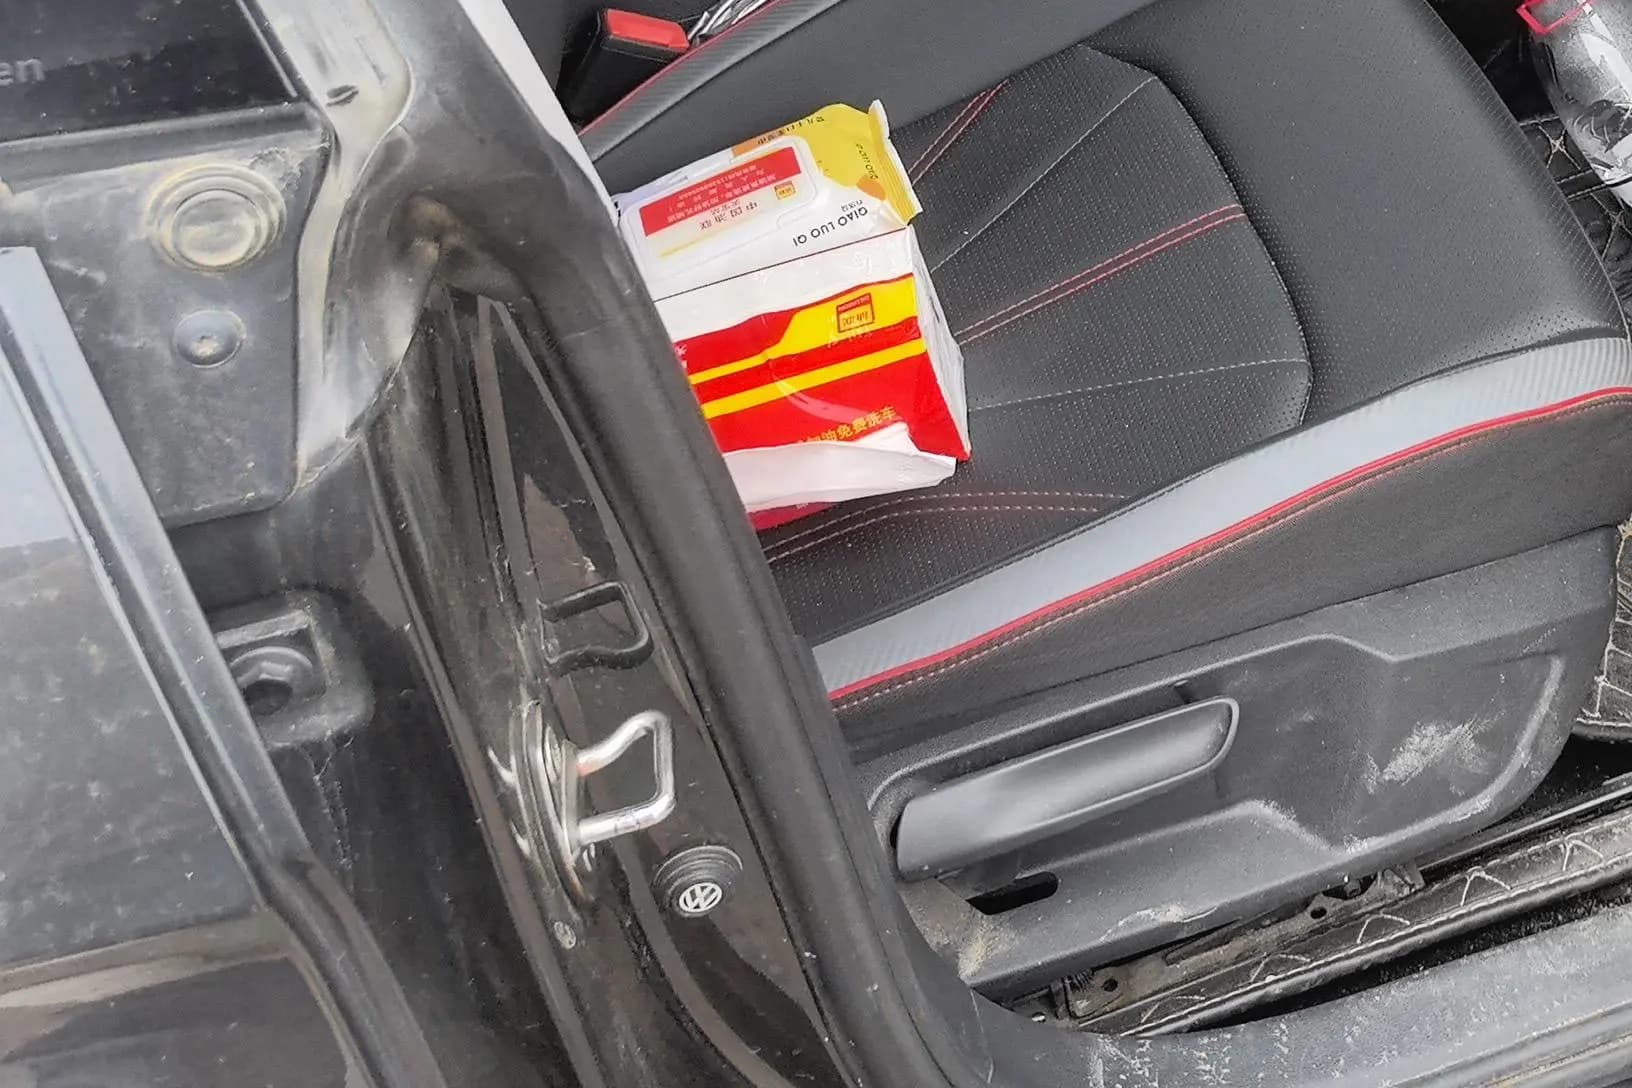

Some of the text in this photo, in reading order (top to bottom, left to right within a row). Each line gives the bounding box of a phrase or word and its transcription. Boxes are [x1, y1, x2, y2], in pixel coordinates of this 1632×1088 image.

[809, 216, 836, 240] LUO
[832, 206, 869, 231] QIAO
[792, 232, 808, 248] QI
